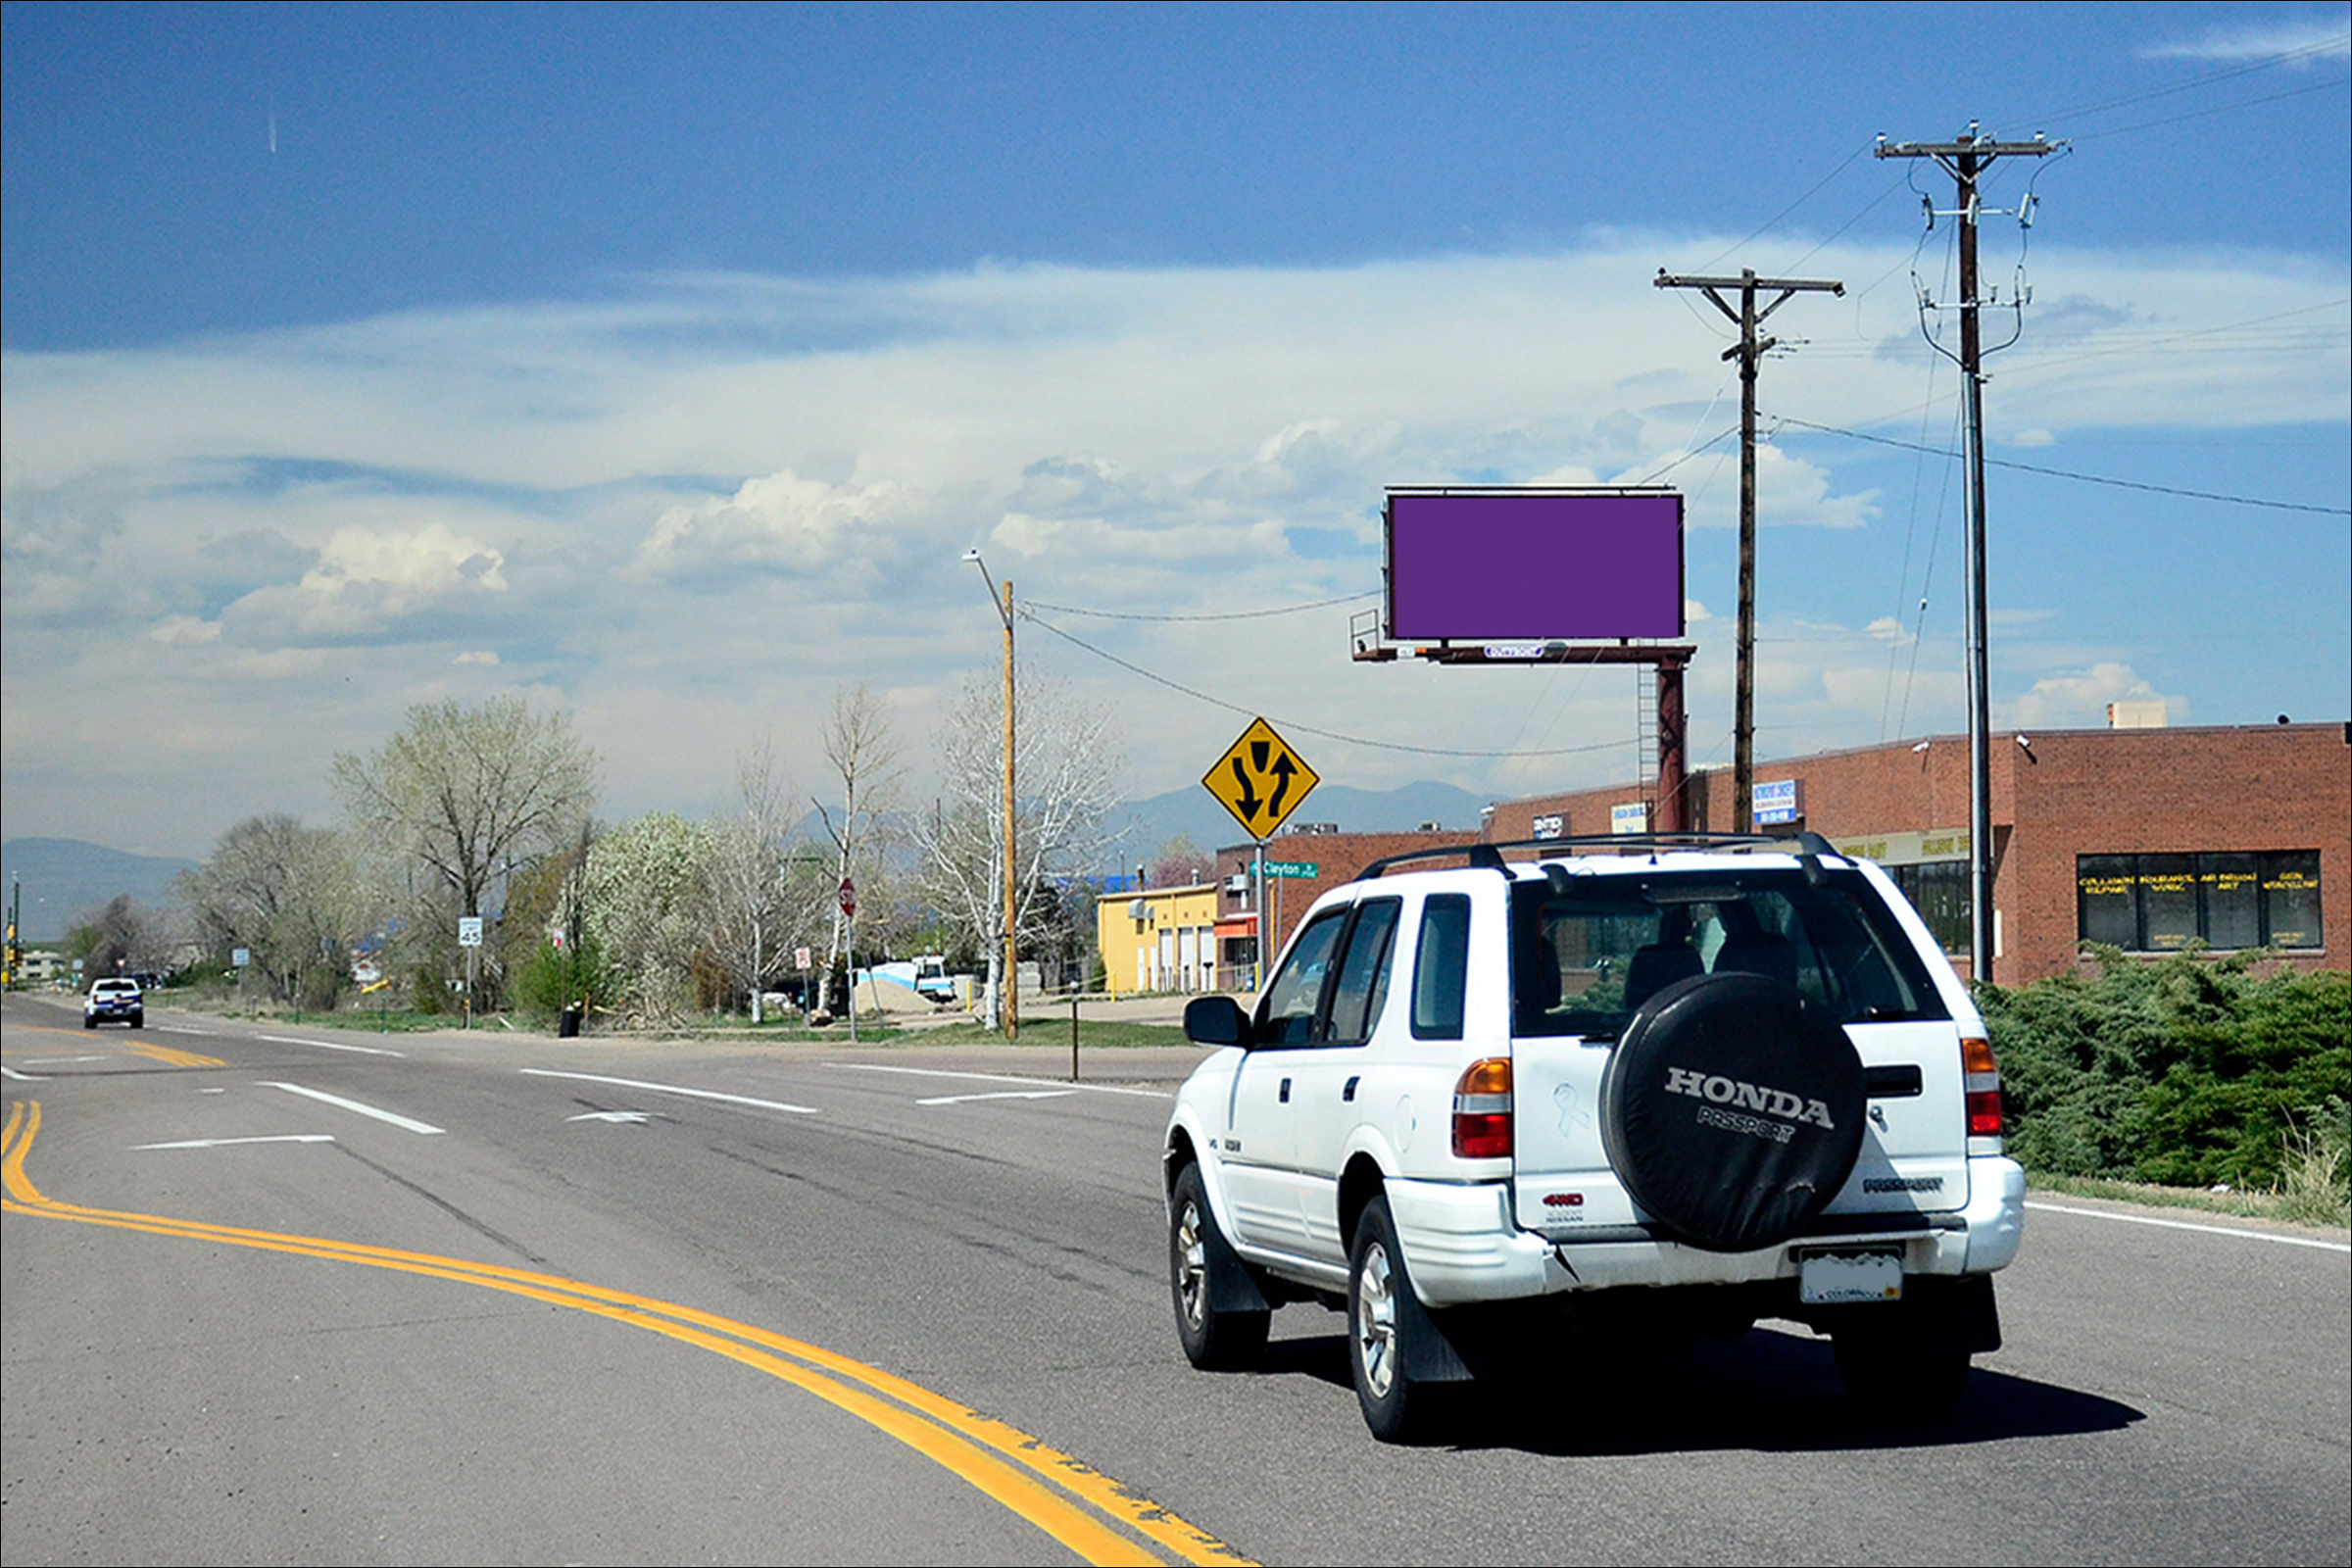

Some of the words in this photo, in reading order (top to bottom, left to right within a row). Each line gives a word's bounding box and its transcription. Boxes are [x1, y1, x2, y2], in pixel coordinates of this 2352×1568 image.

[1264, 861, 1298, 875] Clayton
[462, 932, 480, 943] 45
[1665, 1066, 1835, 1129] HONDA
[1696, 1105, 1796, 1144] PASSPORT
[1863, 1177, 1943, 1194] PASSPORT
